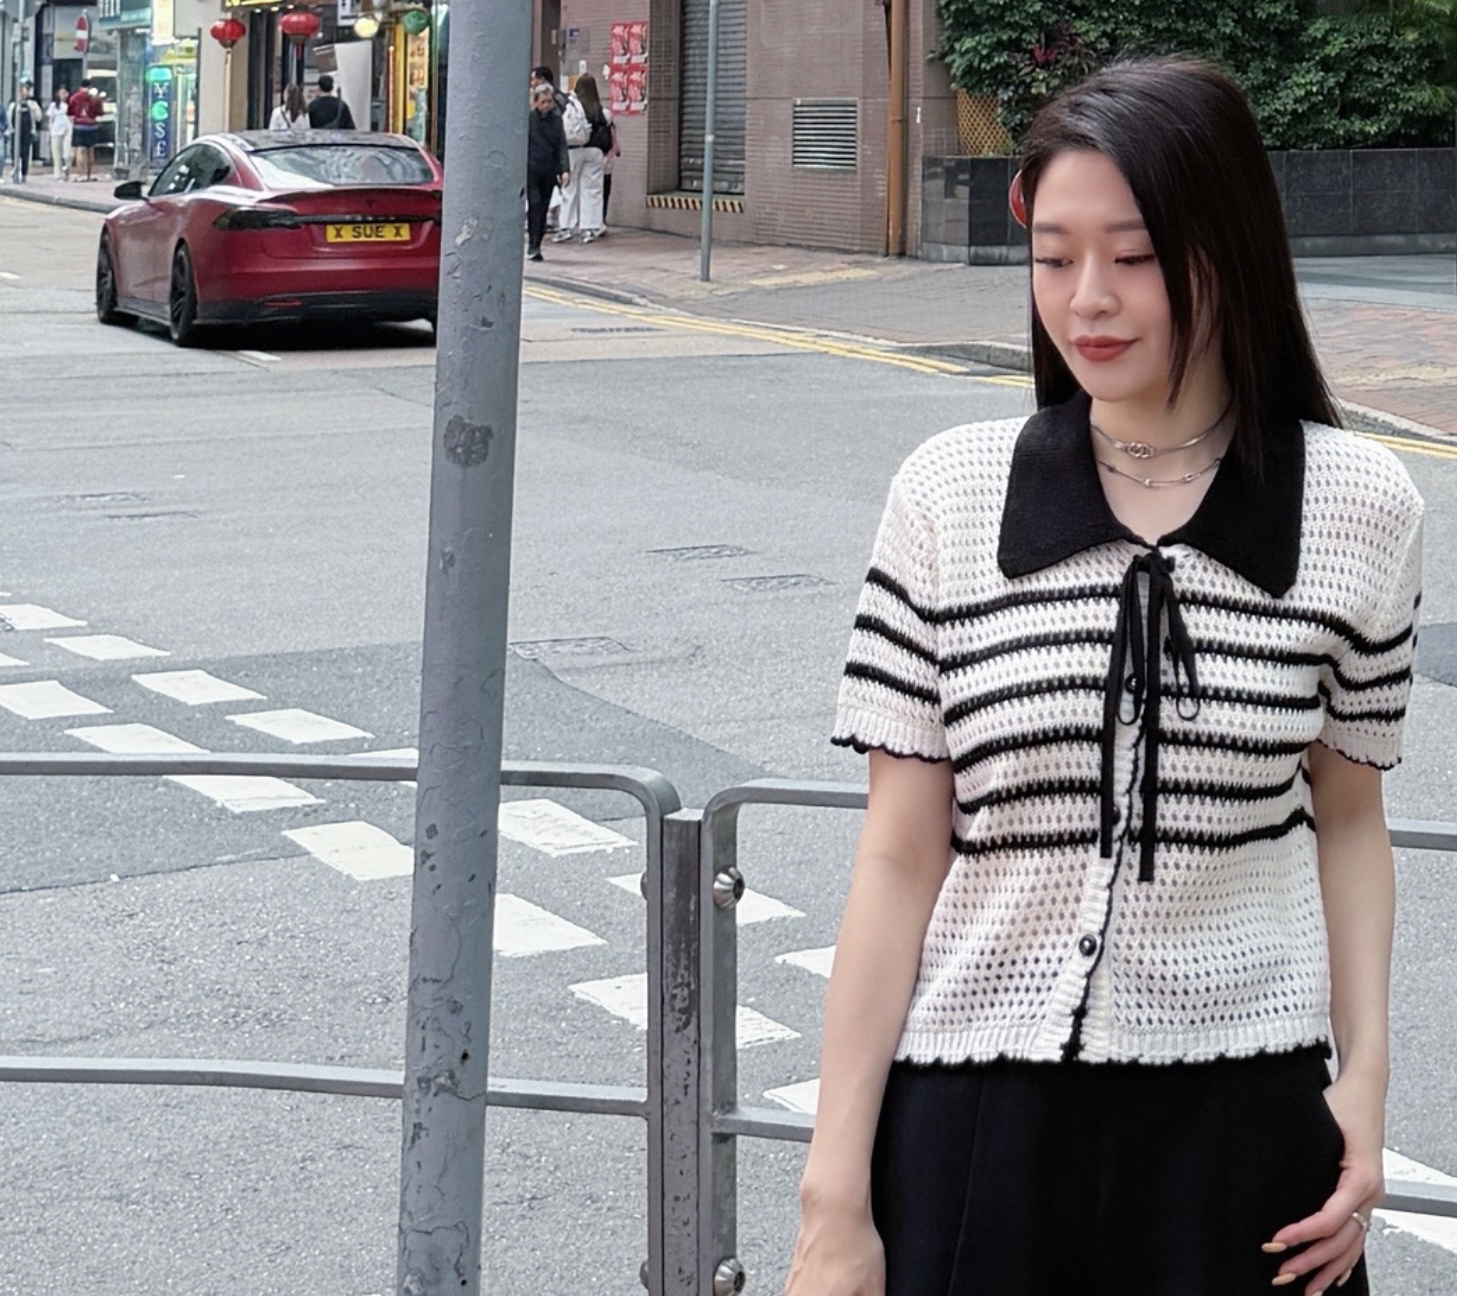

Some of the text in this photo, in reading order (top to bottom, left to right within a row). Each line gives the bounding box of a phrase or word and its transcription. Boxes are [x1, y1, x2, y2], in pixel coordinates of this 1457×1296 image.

[334, 225, 403, 239] X SUE X
